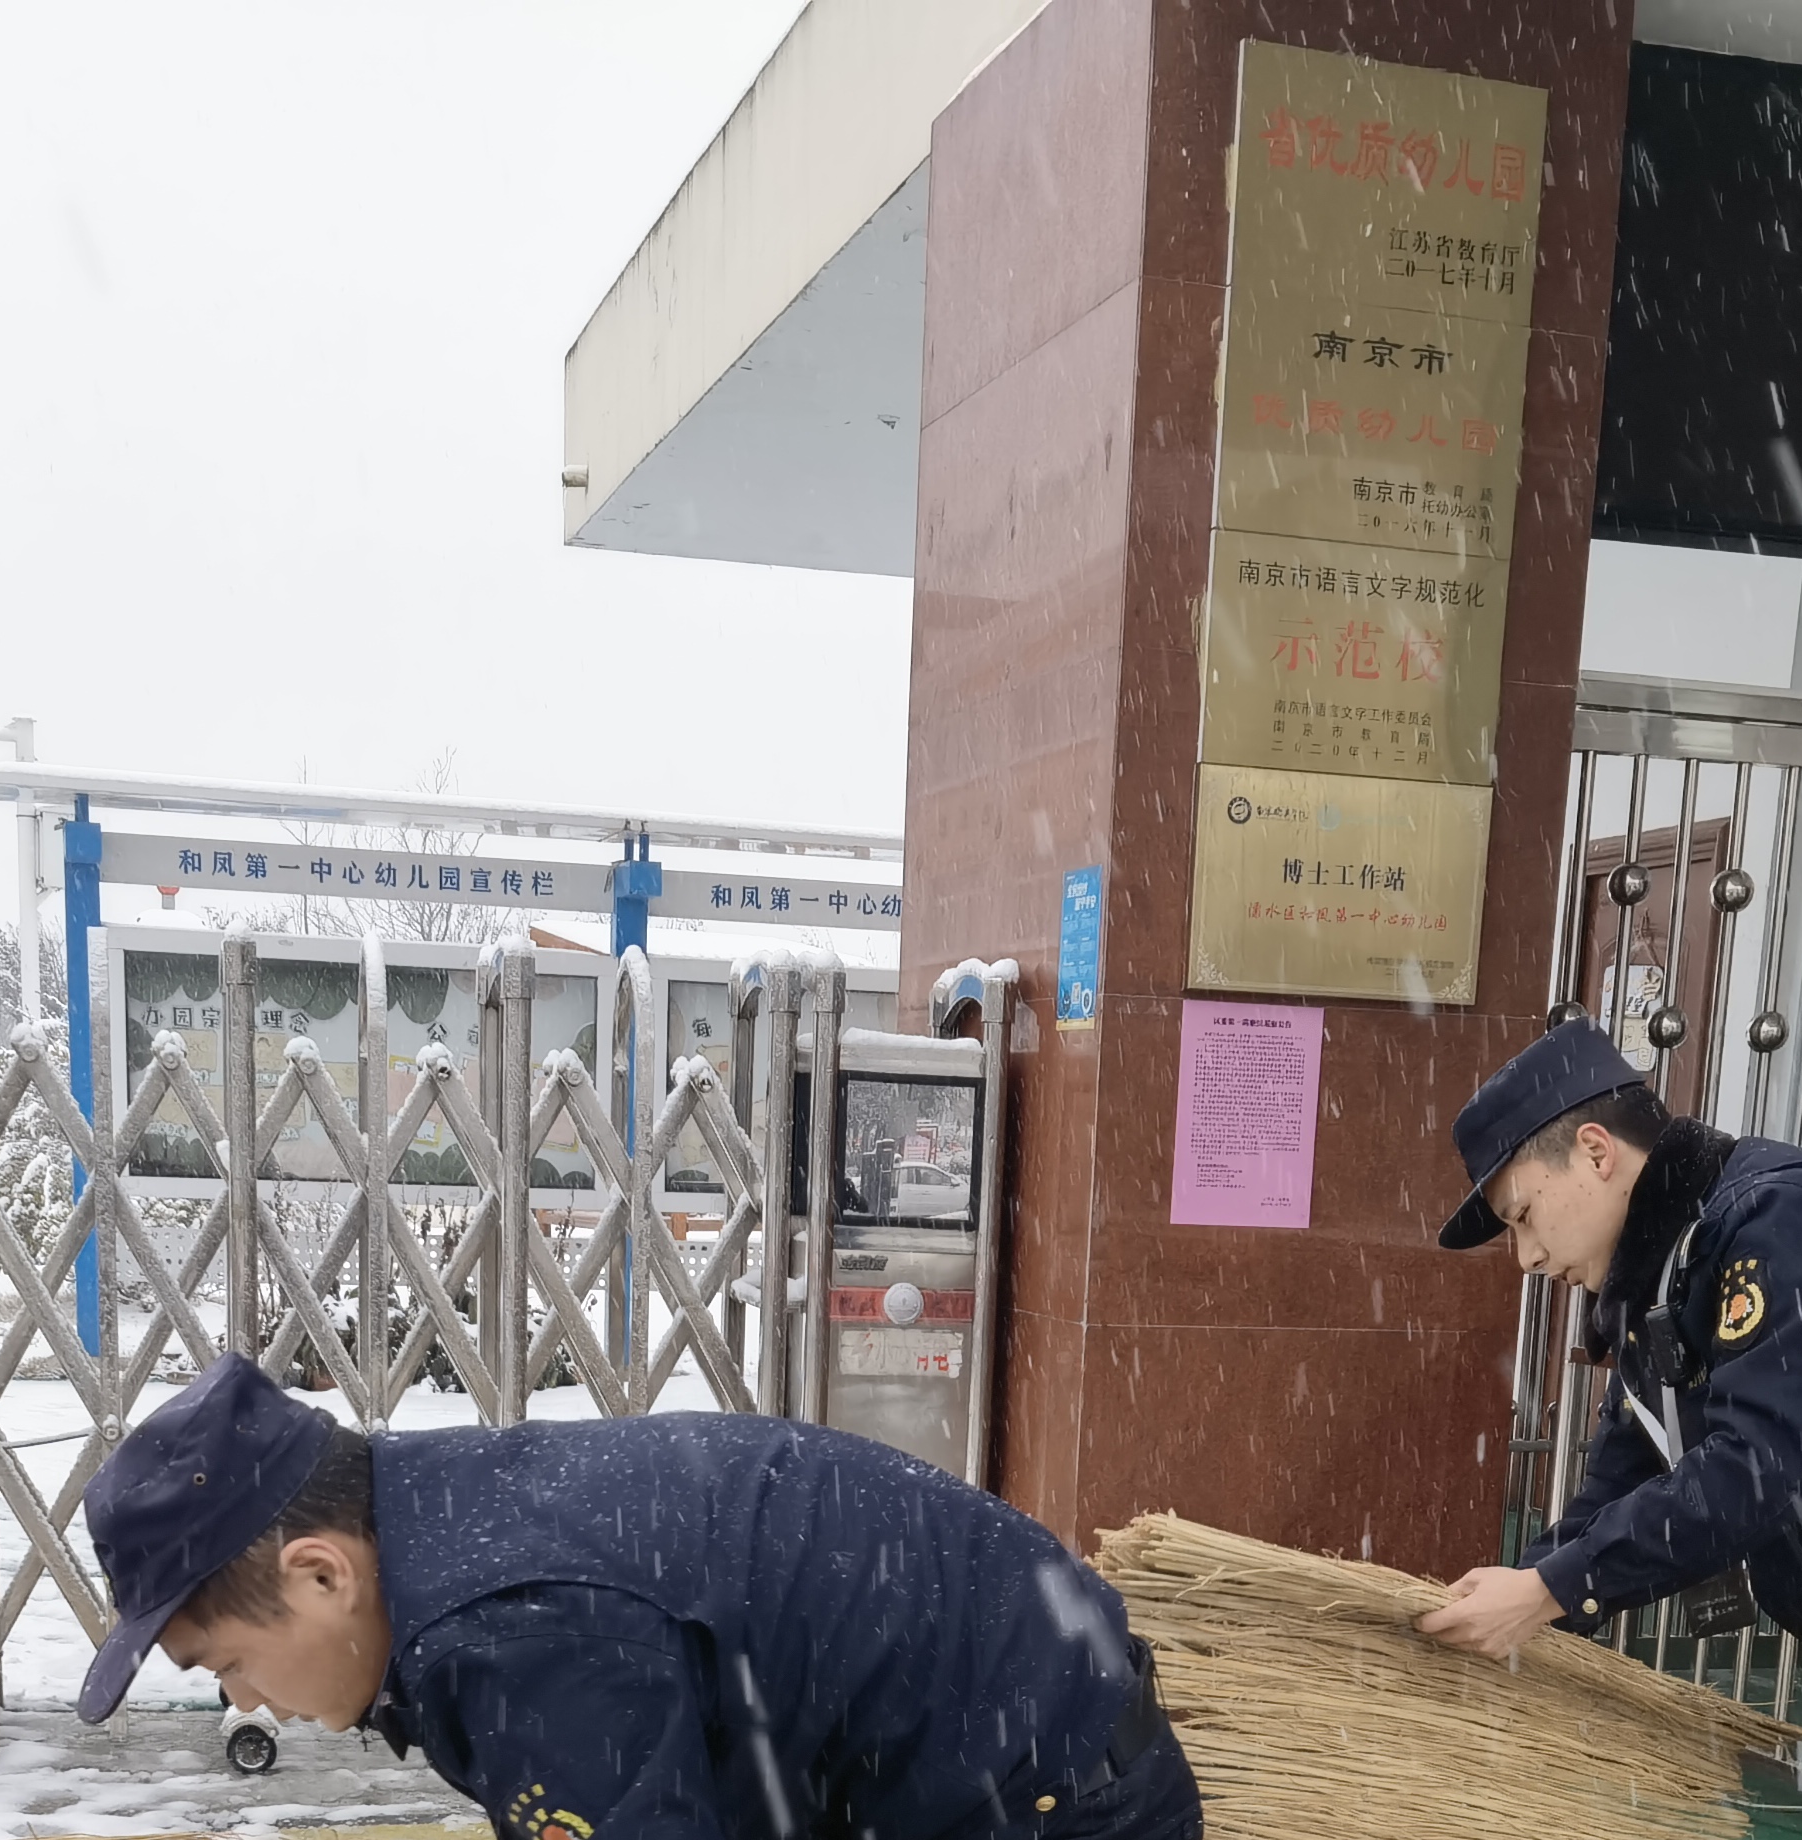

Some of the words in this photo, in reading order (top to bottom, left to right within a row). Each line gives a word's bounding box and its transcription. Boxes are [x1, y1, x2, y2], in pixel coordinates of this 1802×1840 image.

[1259, 107, 1526, 201] 省优质幼儿园
[1389, 227, 1521, 267] 江苏省教育厅
[1312, 330, 1453, 375] 南京市
[1252, 392, 1497, 455] 优质幼儿园
[1353, 476, 1419, 507] 南京市
[1238, 558, 1486, 609] 南京市语言文字规范化
[1270, 617, 1444, 683] 示范校
[1273, 699, 1433, 728] 南京市语言文字工作委员会
[1273, 719, 1431, 748] 南京市教育局
[177, 847, 555, 897] 和凤第一中心幼儿园宣传栏
[1282, 857, 1408, 892] 博士工作站
[710, 883, 902, 918] 和凤第一中心幼
